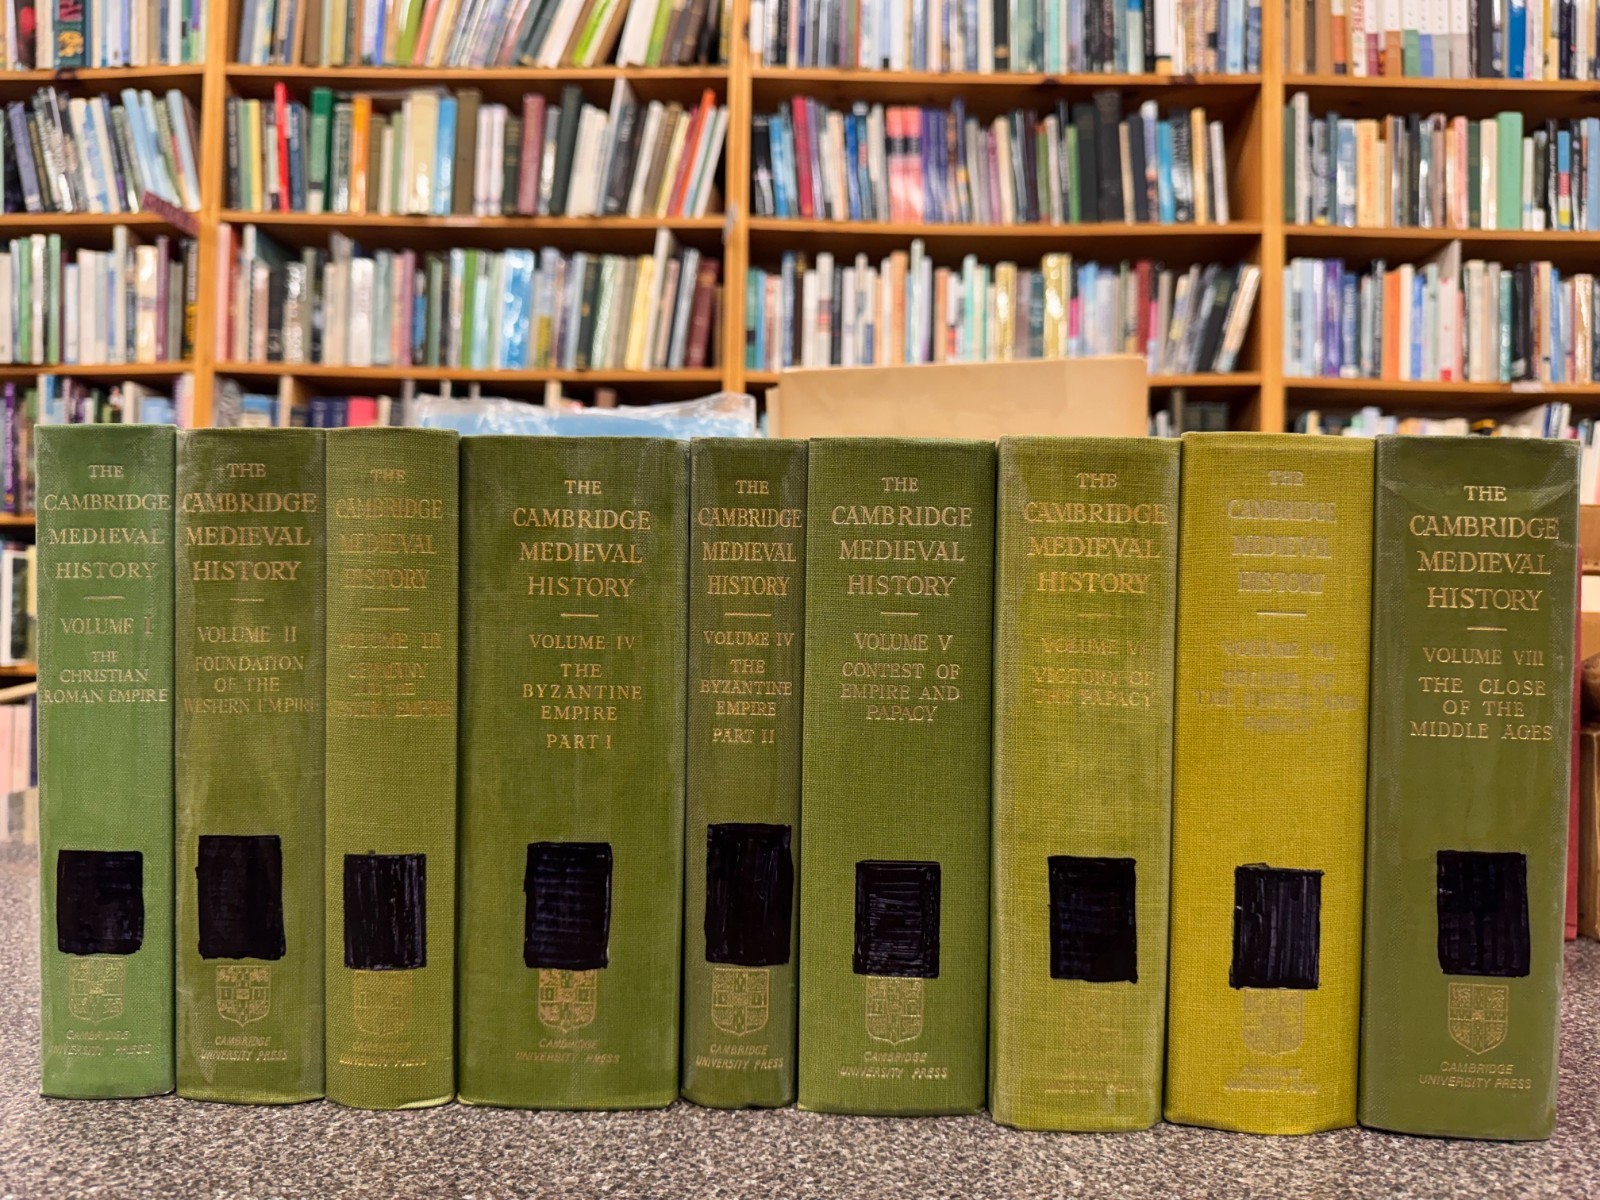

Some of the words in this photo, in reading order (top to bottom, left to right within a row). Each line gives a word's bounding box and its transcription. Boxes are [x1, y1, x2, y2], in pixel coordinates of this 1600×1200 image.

[89, 465, 124, 477] THE
[226, 463, 266, 477] THE
[371, 469, 405, 482] THE
[564, 480, 602, 494] THE
[736, 480, 769, 494] THE
[881, 477, 919, 492] THE
[1076, 473, 1118, 488] THE
[44, 494, 171, 510] CAMBRIDGE
[182, 492, 317, 512] CAMBRIDGE
[1464, 486, 1507, 502] THE
[336, 498, 442, 518] CAMBRIDGE
[831, 505, 972, 527] CAMBRIDGE
[1023, 501, 1168, 524] CAMBRIDGE
[512, 507, 651, 530] CAMBRIDGE
[698, 507, 802, 527] CAMBRIDGE
[1409, 515, 1559, 539] CAMBRIDGE
[48, 527, 165, 544] MEDIEVAL
[185, 526, 311, 546] MEDIEVAL
[340, 533, 435, 554] MEDIEVAL
[519, 542, 643, 563] MEDIEVAL
[702, 542, 796, 562] MEDIEVAL
[839, 540, 965, 562] MEDIEVAL
[1027, 536, 1161, 558] MEDIEVAL
[55, 562, 158, 578] HISTORY
[1417, 550, 1551, 574] MEDIEVAL
[193, 561, 301, 580] HISTORY
[344, 568, 430, 589] HISTORY
[527, 576, 634, 597] HISTORY
[707, 575, 791, 595] HISTORY
[847, 574, 956, 596] HISTORY
[1036, 572, 1151, 593] HISTORY
[1238, 571, 1325, 594] HISTORY
[1427, 587, 1543, 611] HISTORY
[60, 618, 134, 634] VOLUME
[144, 616, 152, 635] I
[197, 626, 270, 642] VOLUME
[284, 626, 296, 642] II
[529, 634, 606, 649] VOLUME
[617, 636, 635, 649] IV
[704, 631, 769, 645] VOLUME
[776, 633, 794, 646] IV
[853, 633, 928, 650] VOLUME
[938, 634, 953, 650] V
[92, 651, 118, 662] THE
[195, 656, 304, 671] FOUNDATION
[1423, 647, 1502, 664] VOLUME
[1513, 650, 1544, 666] VIII
[560, 664, 602, 677] THE
[730, 659, 765, 673] THE
[842, 662, 925, 678] CONTEST
[936, 664, 960, 679] OF
[60, 669, 149, 682] CHRISTIAN
[215, 678, 236, 692] OF
[244, 678, 280, 692] THE
[522, 684, 642, 700] BYZANTINE
[700, 680, 792, 695] BYZANTINE
[840, 683, 910, 700] EMPIRE
[919, 686, 960, 700] AND
[1418, 677, 1463, 693] THE
[1479, 678, 1546, 696] CLOSE
[43, 689, 103, 702] ROMAN
[109, 689, 168, 702] EMPIRE
[183, 698, 250, 714] WESTERN
[541, 705, 618, 720] EMPIRE
[716, 701, 776, 715] EMPIRE
[866, 705, 938, 721] PAPACY
[1443, 700, 1471, 715] OF
[1482, 701, 1525, 717] THE
[712, 728, 754, 743] PART
[762, 729, 775, 743] II
[1410, 721, 1489, 738] MIDDLE
[1501, 724, 1552, 740] AGES
[546, 734, 599, 749] PART
[606, 735, 612, 749] I
[215, 1036, 271, 1046] CAMBRIDGE
[540, 1038, 598, 1048] CAMBRIDGE
[200, 1049, 253, 1060] UNIVERSITY
[256, 1050, 287, 1060] PRESS
[710, 1044, 768, 1055] CAMBRIDGE
[864, 1052, 928, 1063] CAMBRIDGE
[585, 1054, 620, 1064] PRESS
[696, 1056, 750, 1069] UNIVERSITY
[754, 1058, 783, 1070] PRESS
[840, 1066, 903, 1078] UNIVERSITY
[912, 1068, 948, 1079] PRESS
[1440, 1061, 1514, 1075] CAMBRIDGE
[1418, 1074, 1491, 1088] UNIVERSITY
[1494, 1078, 1532, 1089] PRESS
